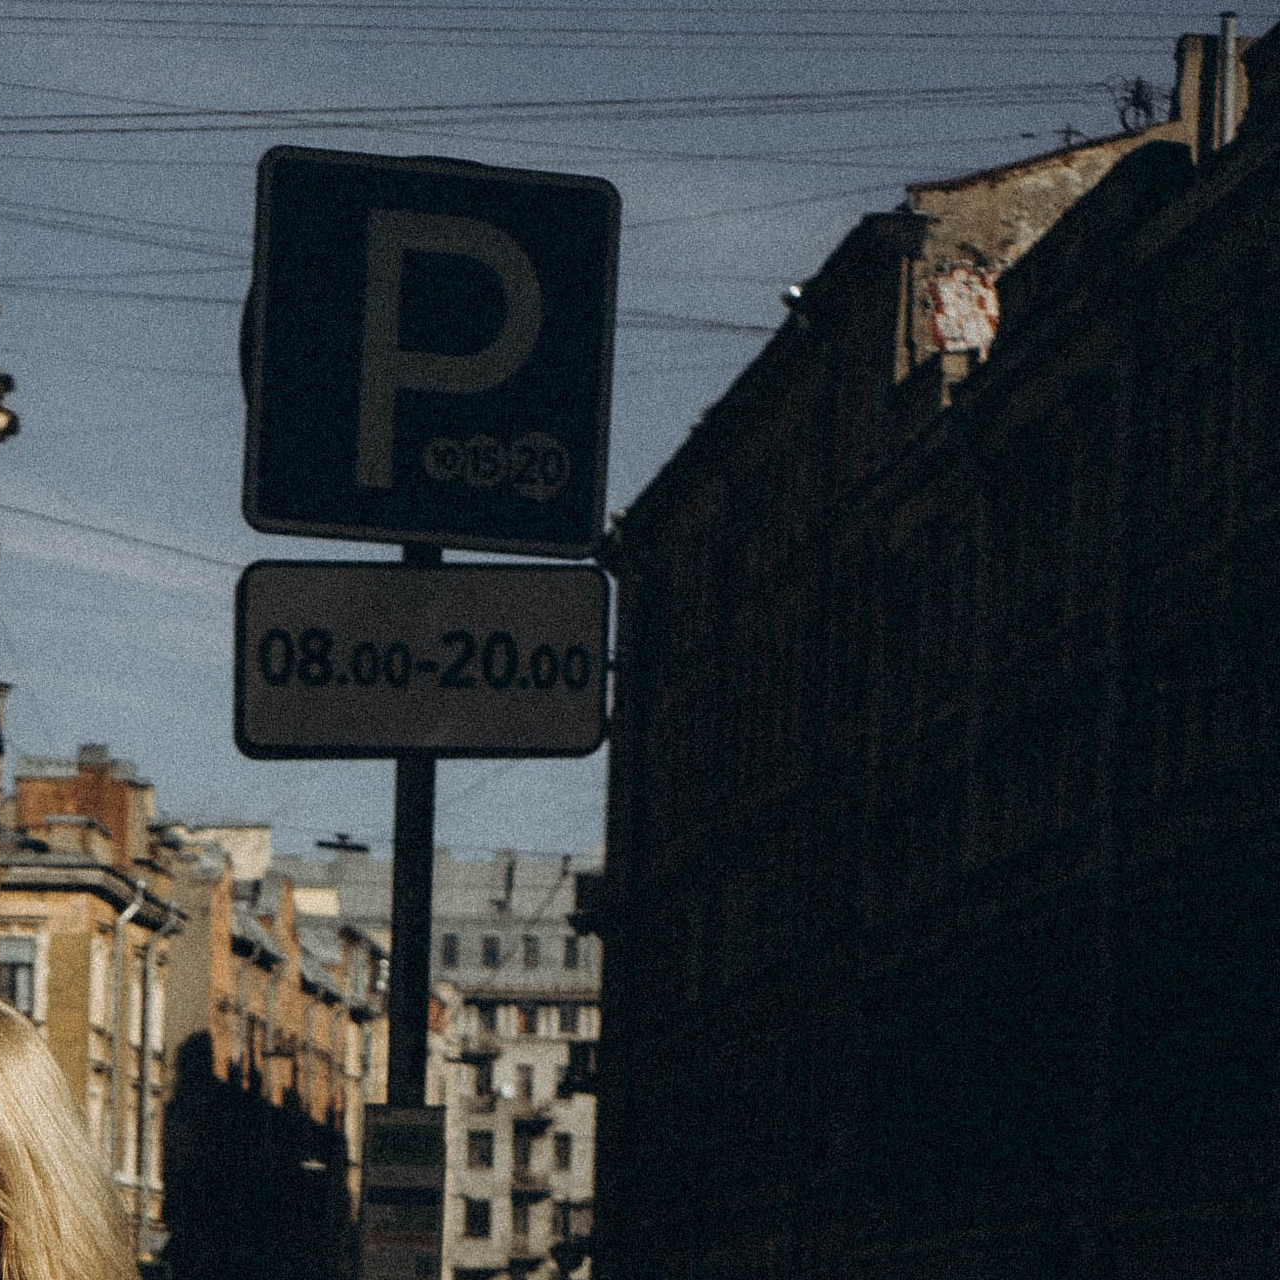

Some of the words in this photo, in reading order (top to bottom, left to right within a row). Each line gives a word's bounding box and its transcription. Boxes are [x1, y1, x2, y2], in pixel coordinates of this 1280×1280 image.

[356, 209, 543, 488] P
[515, 443, 565, 487] 20
[259, 628, 592, 690] 08.00-20.00
